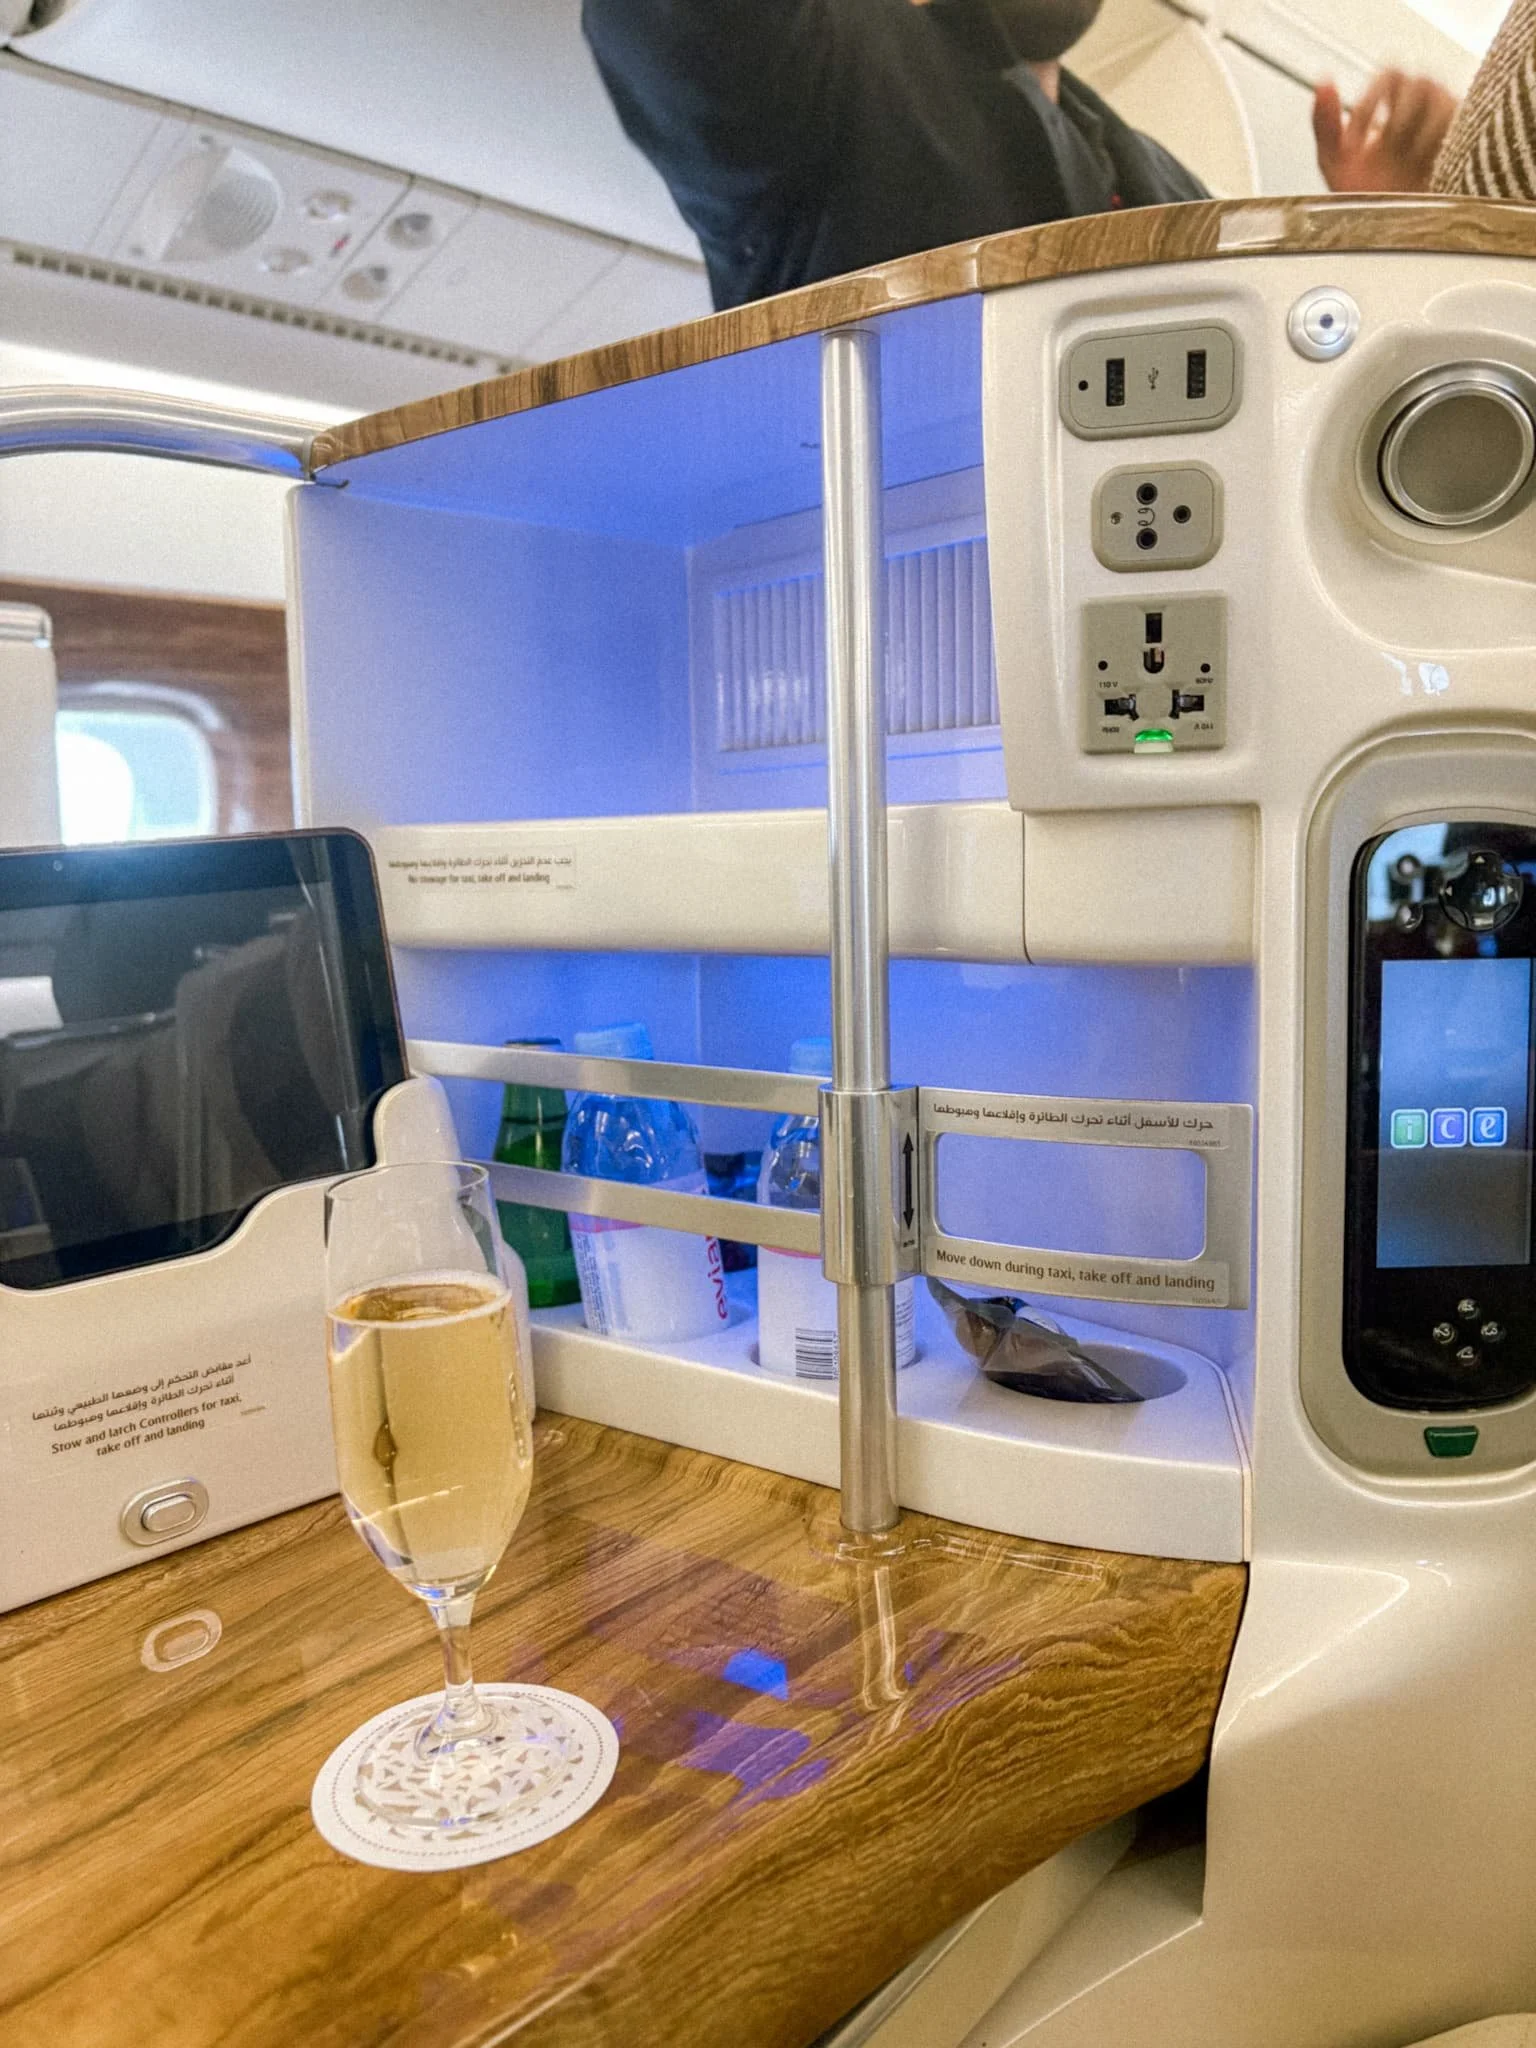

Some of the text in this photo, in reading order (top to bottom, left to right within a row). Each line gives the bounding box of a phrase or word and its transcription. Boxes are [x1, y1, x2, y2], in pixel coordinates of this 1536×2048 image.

[494, 872, 506, 882] off
[508, 872, 520, 882] and
[522, 872, 550, 884] landing
[1028, 1111, 1068, 1124] الطائرة
[1071, 1113, 1103, 1126] تحرك
[1107, 1113, 1131, 1126] أثناء
[1183, 1118, 1214, 1132] حرك
[704, 1235, 728, 1320] evia
[936, 1249, 1215, 1292] Move down during taxi, take off and landing
[151, 1378, 164, 1391] إلى
[215, 1372, 234, 1387] أثناء
[187, 1382, 213, 1395] تحرك
[150, 1388, 184, 1406] الطائرة
[51, 1392, 242, 1454] Stow and latch Controllers for taxi,
[96, 1419, 205, 1456] take off and landing
